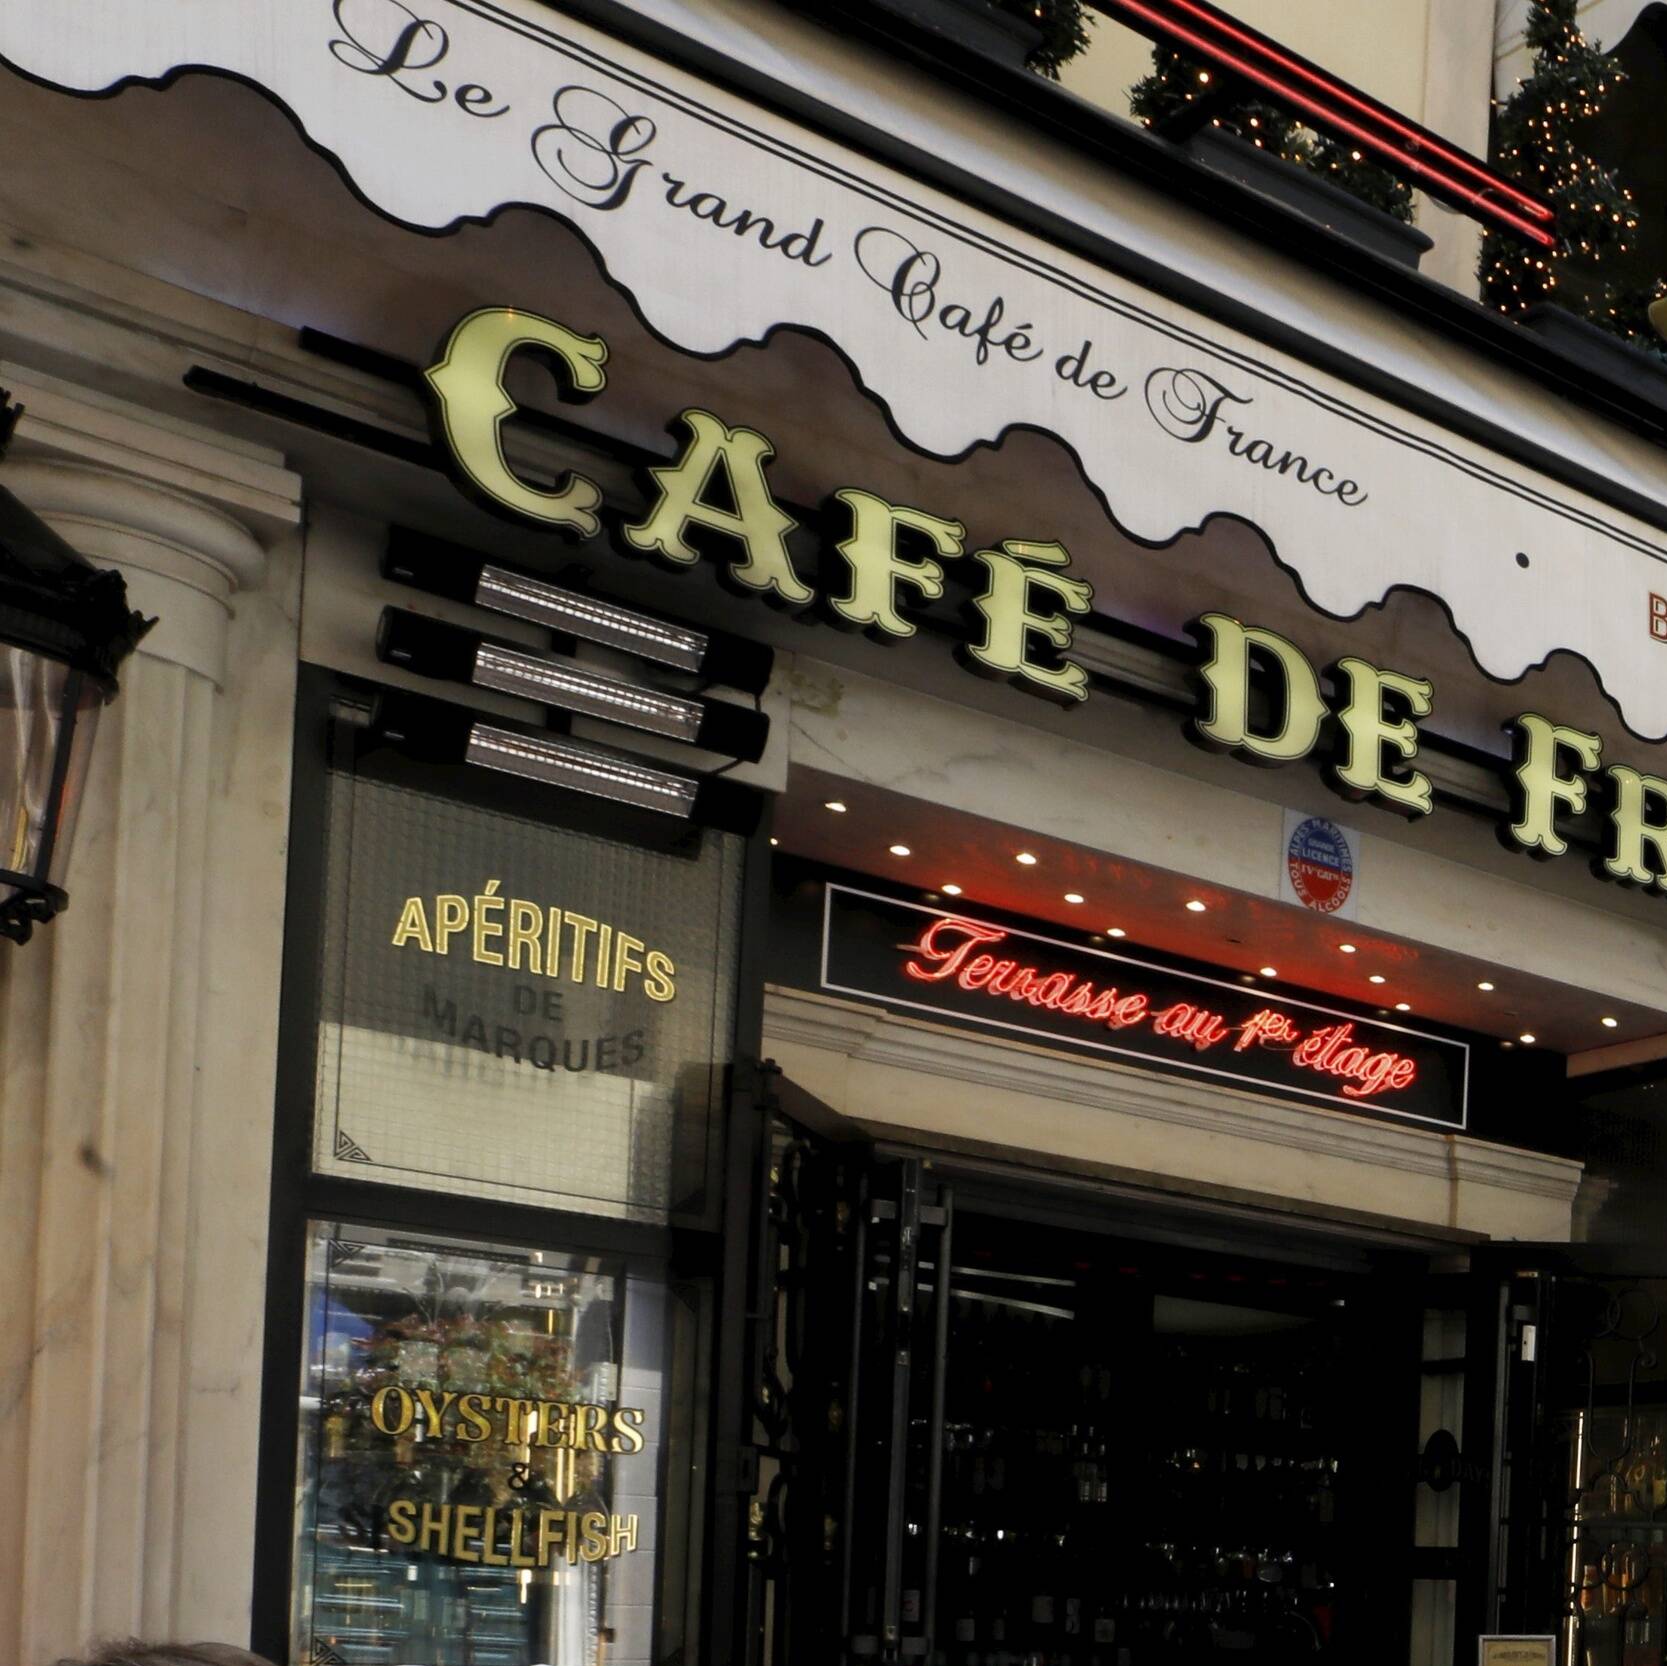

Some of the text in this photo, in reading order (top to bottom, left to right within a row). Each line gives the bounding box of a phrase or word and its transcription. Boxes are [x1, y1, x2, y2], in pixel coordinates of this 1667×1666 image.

[329, 0, 1367, 507] Le Grand Café de France
[424, 307, 1093, 702] CAFÉ
[1199, 612, 1435, 815] DE
[1289, 861, 1308, 897] TOUS
[1309, 877, 1352, 912] ALCOOLS
[391, 879, 677, 1003] APÉRITIFS
[423, 986, 645, 1074] MARQUES
[512, 984, 563, 1024] DE
[905, 916, 1149, 1029] Terrasse
[1153, 1000, 1228, 1048] au
[1292, 1022, 1418, 1098] étage
[370, 1385, 645, 1455] OYSTERS
[508, 1461, 529, 1490] &
[387, 1499, 640, 1568] SHELLFISH
